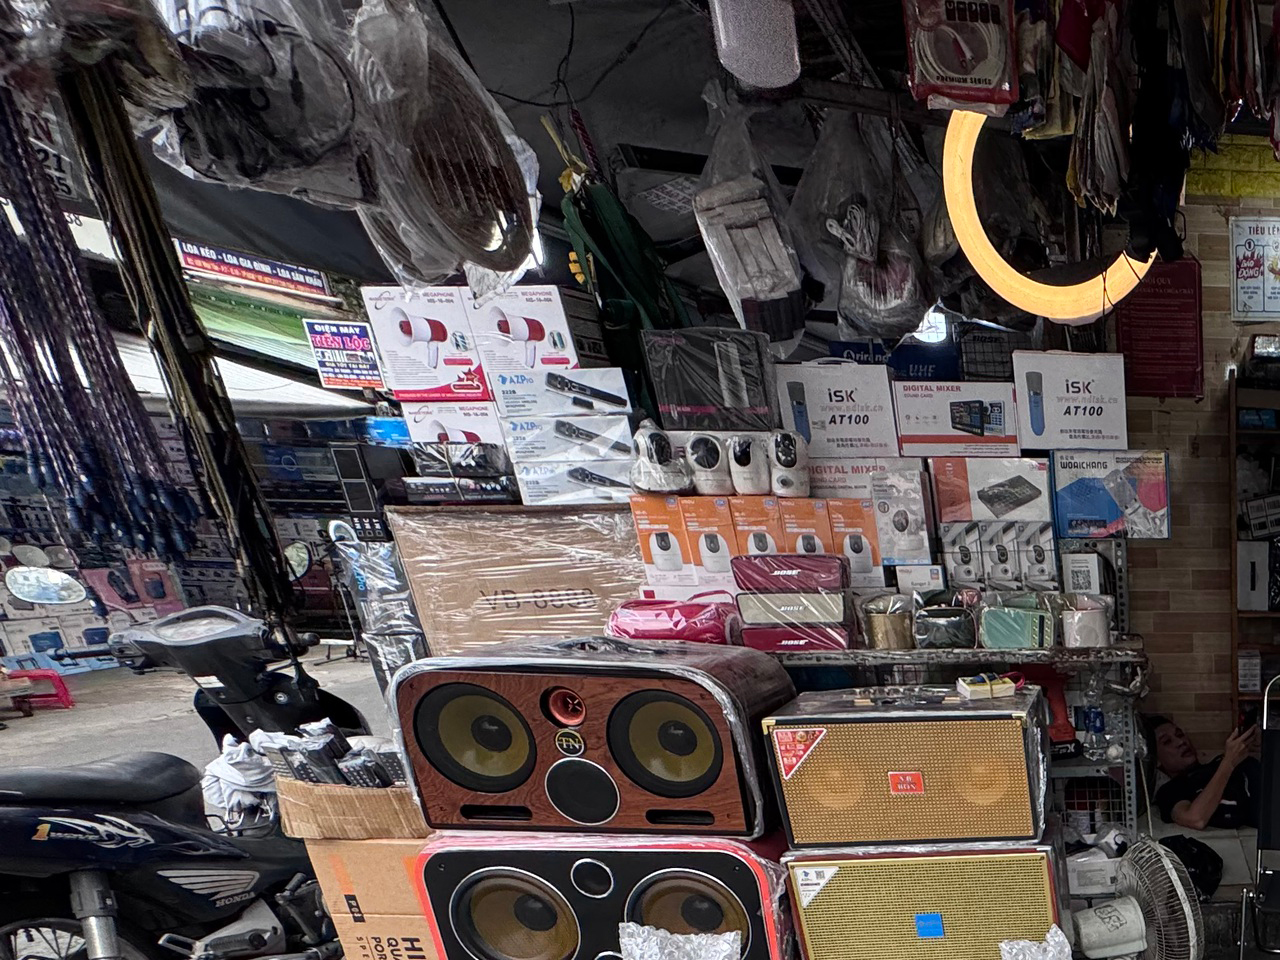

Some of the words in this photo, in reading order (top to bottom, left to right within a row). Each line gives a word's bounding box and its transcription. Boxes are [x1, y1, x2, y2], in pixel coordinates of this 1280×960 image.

[843, 350, 891, 362] Arirng
[903, 384, 934, 392] DIGITAL
[1063, 406, 1104, 416] AT100
[828, 414, 870, 425] AT100
[215, 891, 256, 907] HONDA
